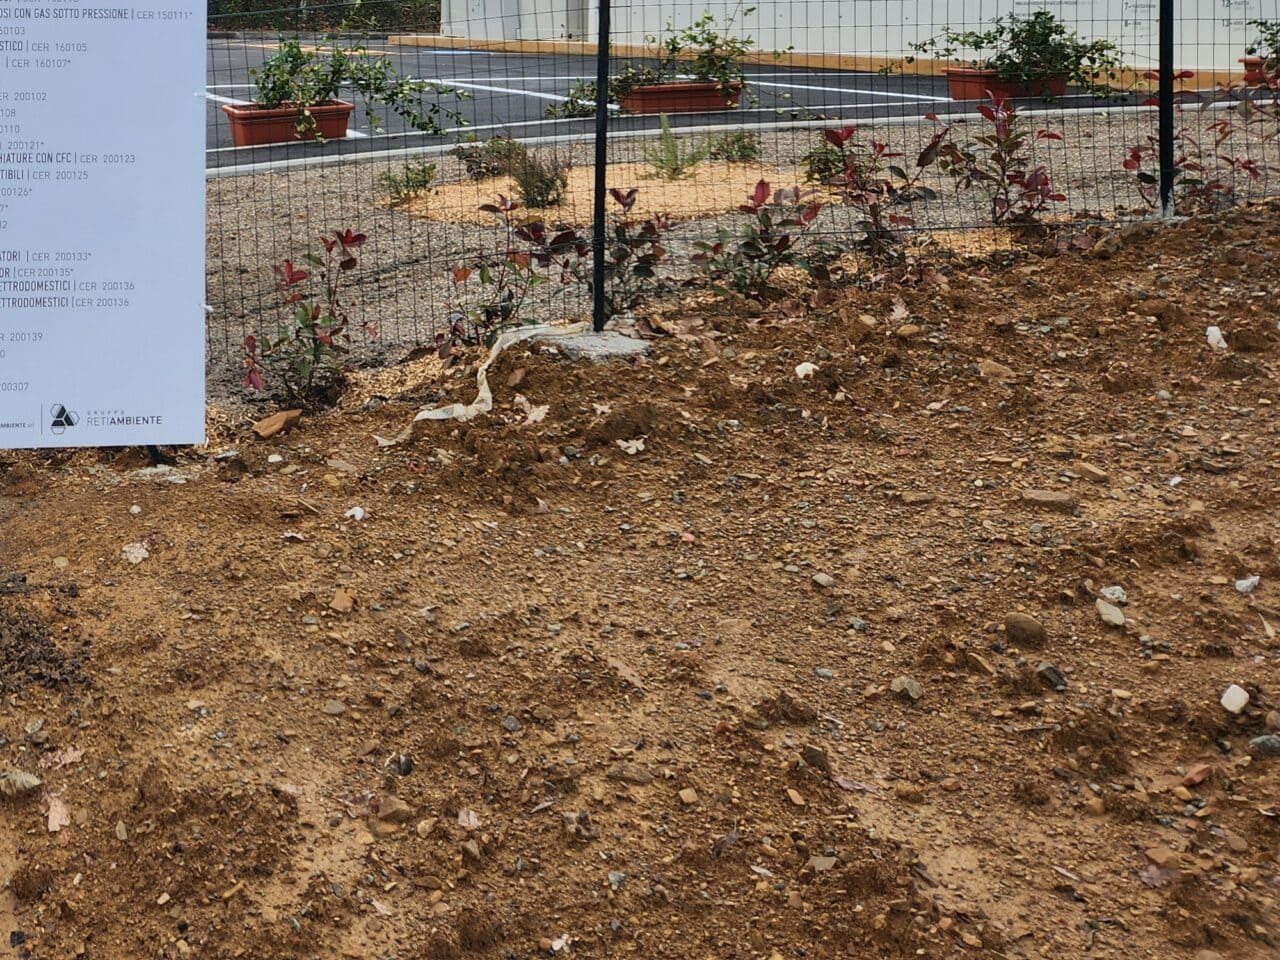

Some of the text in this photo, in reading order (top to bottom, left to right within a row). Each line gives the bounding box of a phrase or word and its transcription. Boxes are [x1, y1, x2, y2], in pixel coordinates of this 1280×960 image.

[14, 9, 31, 19] CON
[34, 9, 50, 19] GAS
[52, 9, 80, 19] SOTTO
[82, 9, 129, 19] PRESSIONE
[31, 43, 49, 52] CER
[36, 153, 53, 163] CON
[55, 153, 72, 163] CFC
[80, 154, 98, 163] CER
[32, 171, 50, 180] CER
[79, 282, 97, 291] CER
[76, 299, 93, 307] CER
[87, 415, 163, 426] RETIAMBIENTE
